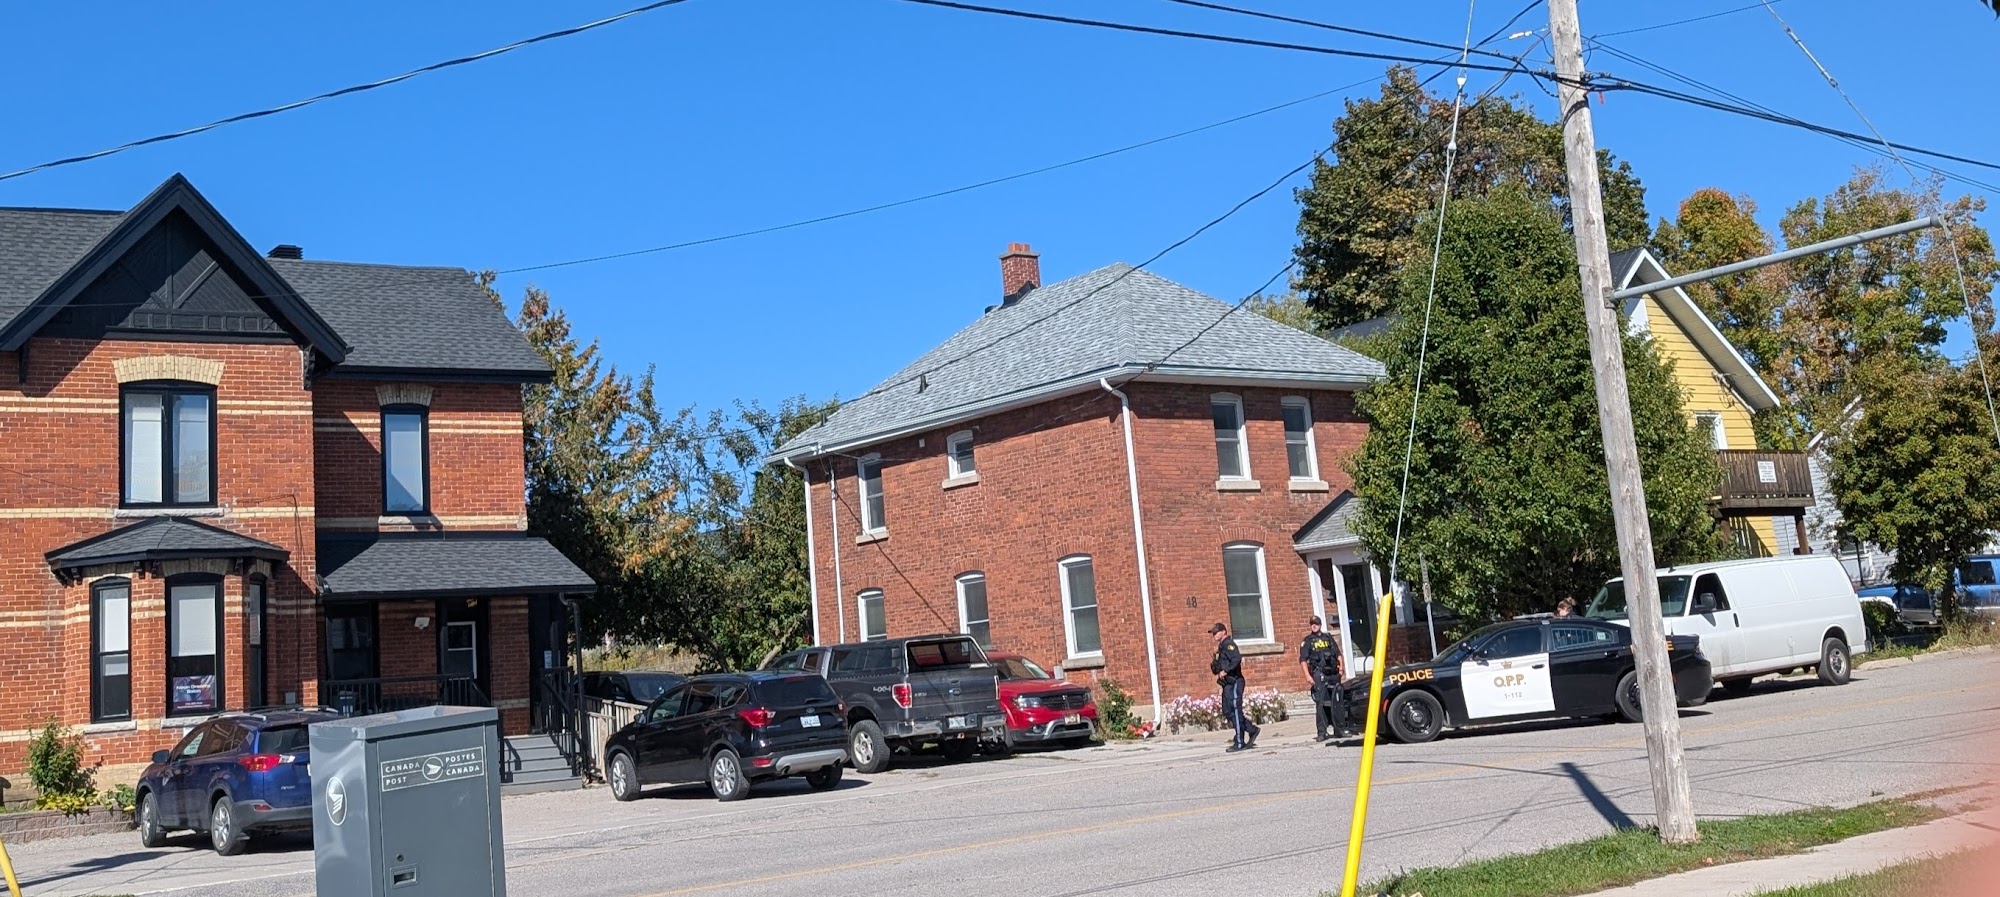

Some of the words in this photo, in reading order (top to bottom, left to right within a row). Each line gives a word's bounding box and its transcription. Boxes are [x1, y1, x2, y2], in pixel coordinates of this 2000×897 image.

[1186, 596, 1198, 608] 48
[1389, 669, 1434, 685] POLICE
[1493, 674, 1527, 688] O.P.P.
[445, 752, 476, 764] POSTES
[385, 762, 421, 773] CANADA
[446, 765, 480, 776] CANADA
[385, 776, 407, 786] POST
